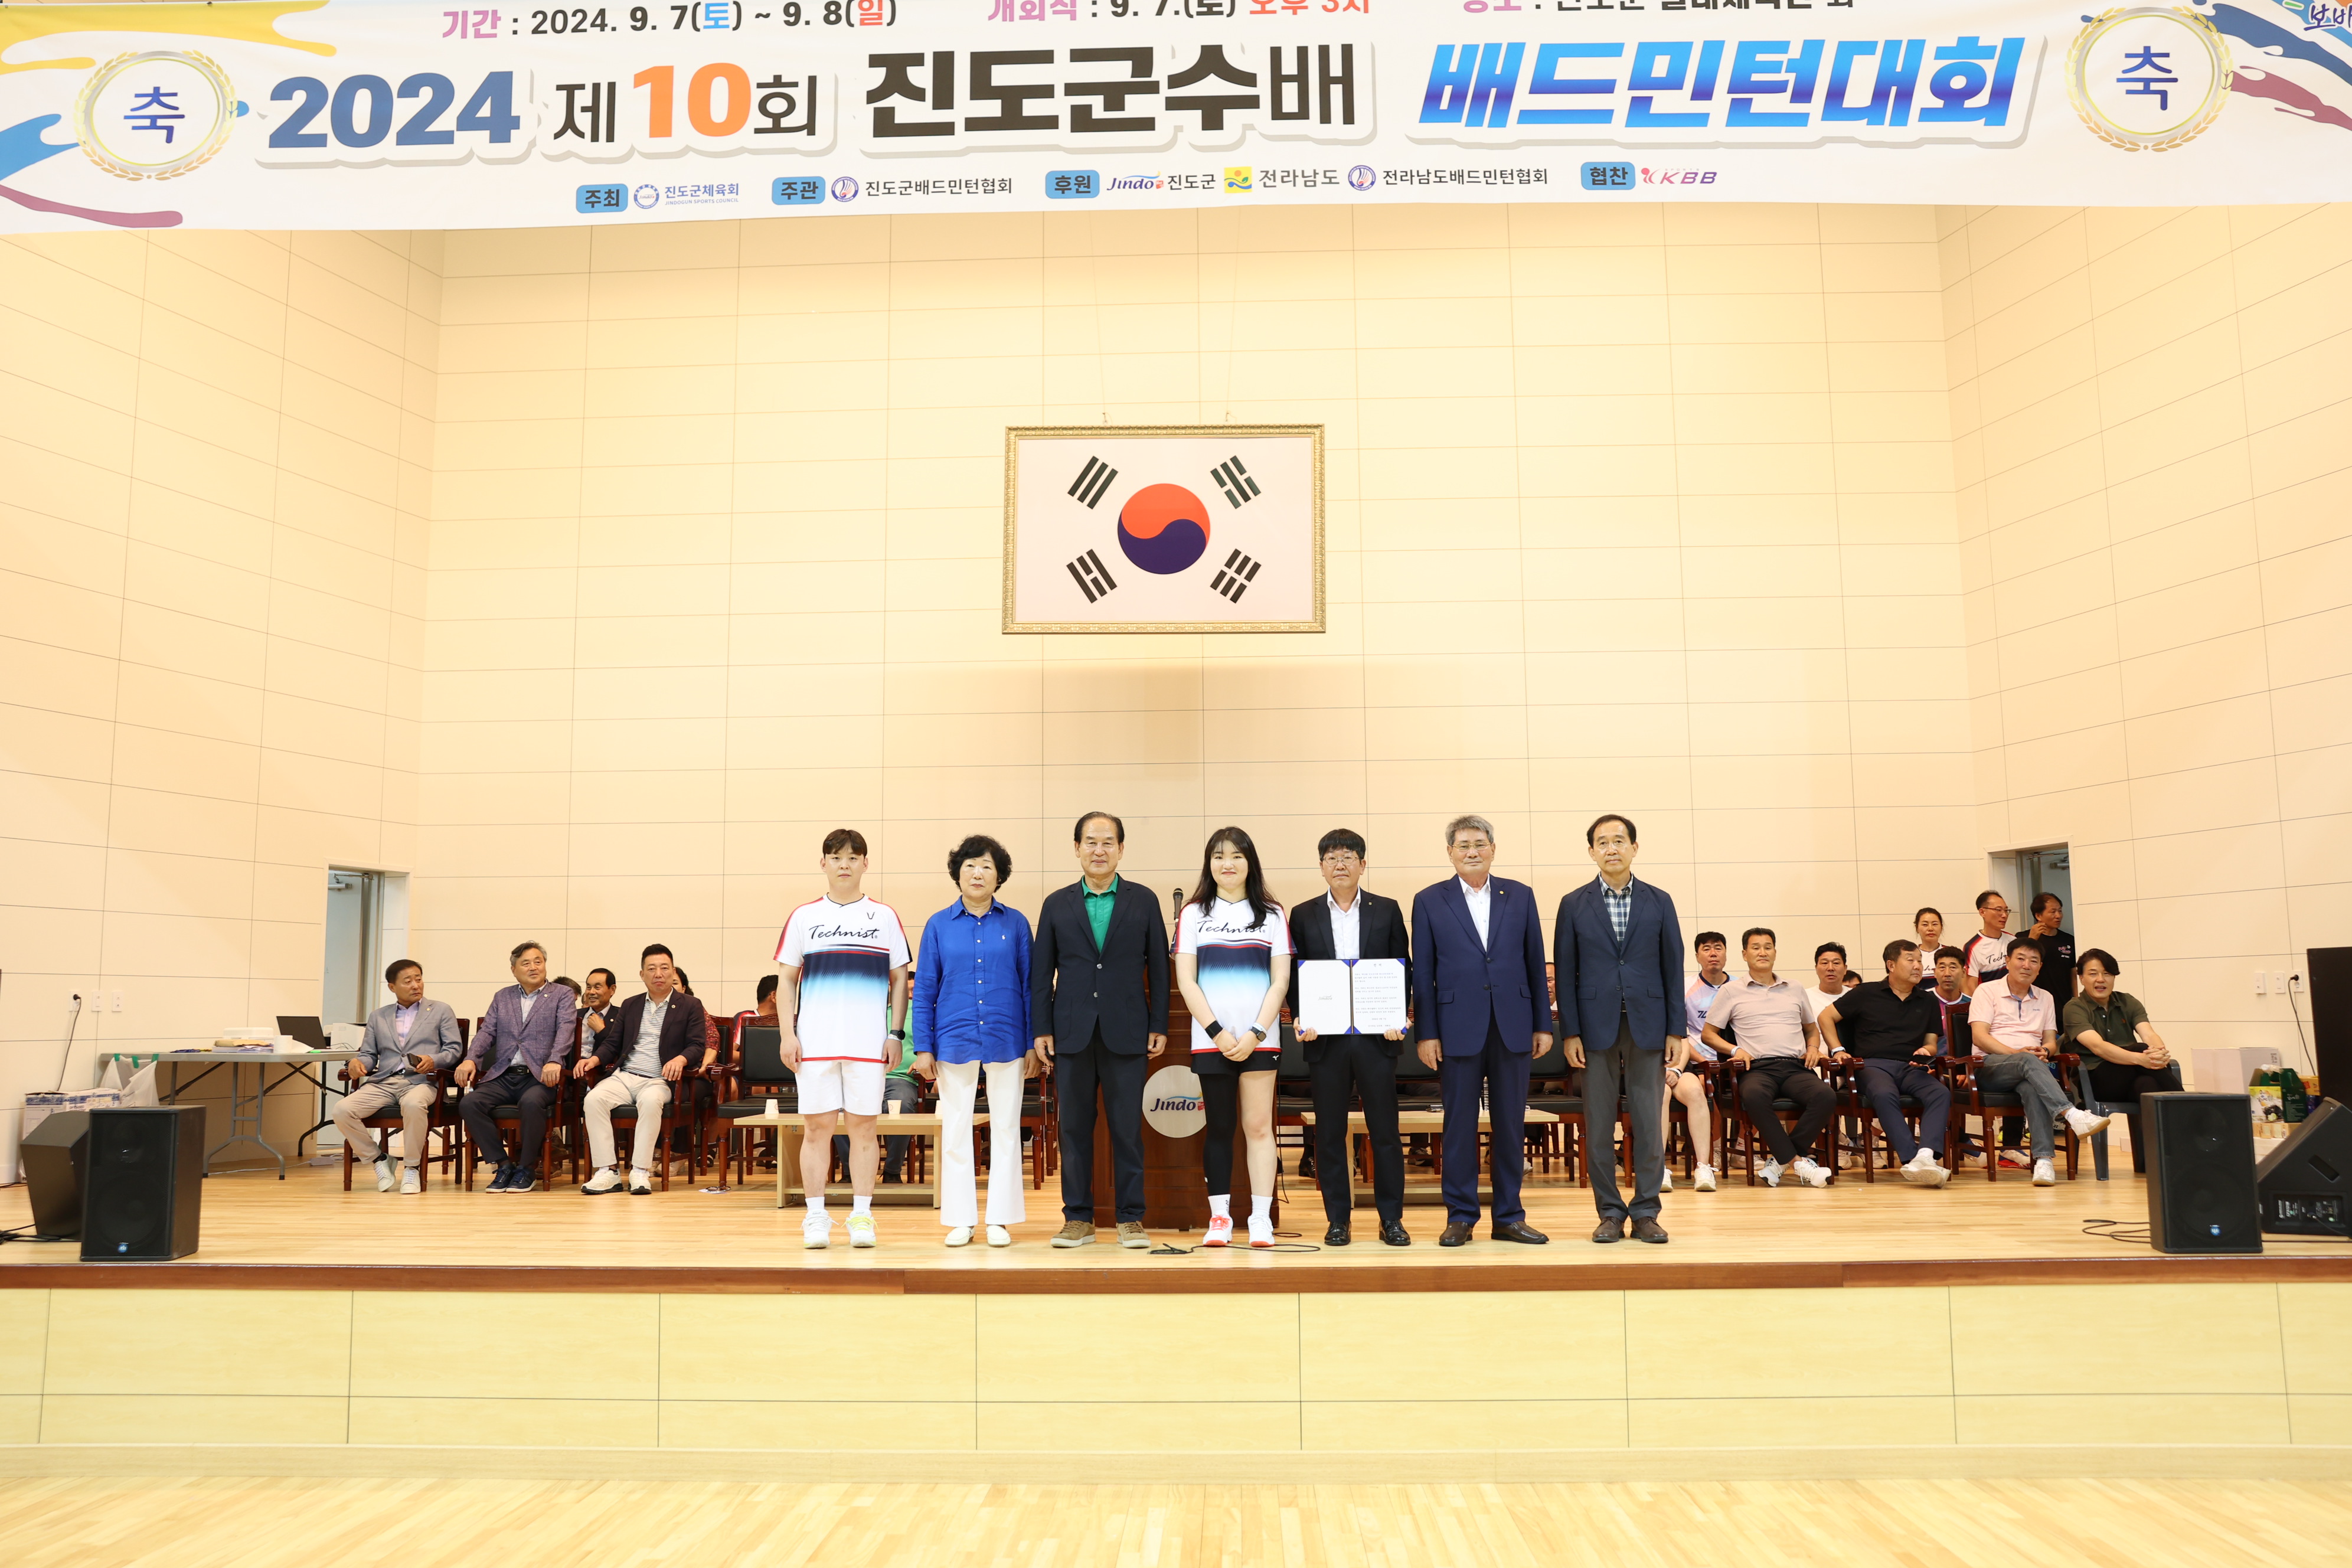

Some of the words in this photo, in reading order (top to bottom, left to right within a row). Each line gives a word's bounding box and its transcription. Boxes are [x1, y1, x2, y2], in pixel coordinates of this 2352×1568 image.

[443, 9, 501, 39] 기간
[531, 8, 617, 35] 2024.
[630, 6, 657, 31] 9.
[671, 1, 742, 32] 7(토)
[783, 2, 811, 27] 9.
[823, 0, 896, 27] 8(일)
[988, 0, 1077, 22] 개회식
[1110, 0, 1138, 18] 9.
[2116, 45, 2178, 111] 축
[269, 71, 521, 148] 2024
[553, 62, 817, 143] 제10회
[866, 44, 1355, 138] 진도군수배
[1419, 36, 2026, 128] 배드민턴대회
[123, 86, 185, 144] 축
[1054, 175, 1091, 194] 후원
[1106, 178, 1154, 191] Jindo
[1168, 174, 1216, 190] 진도군
[1259, 169, 1340, 188] 전라남도
[1383, 169, 1547, 185] 전라남도배드민턴협회
[1589, 166, 1628, 185] 협찬
[1660, 172, 1717, 184] KBB
[584, 188, 620, 208] 주최
[665, 183, 739, 198] 진도군체육회
[781, 181, 818, 200] 주관
[865, 178, 1012, 196] 진도군배드민턴협회
[809, 925, 880, 939] Technist
[1150, 1098, 1196, 1112] Jindo
